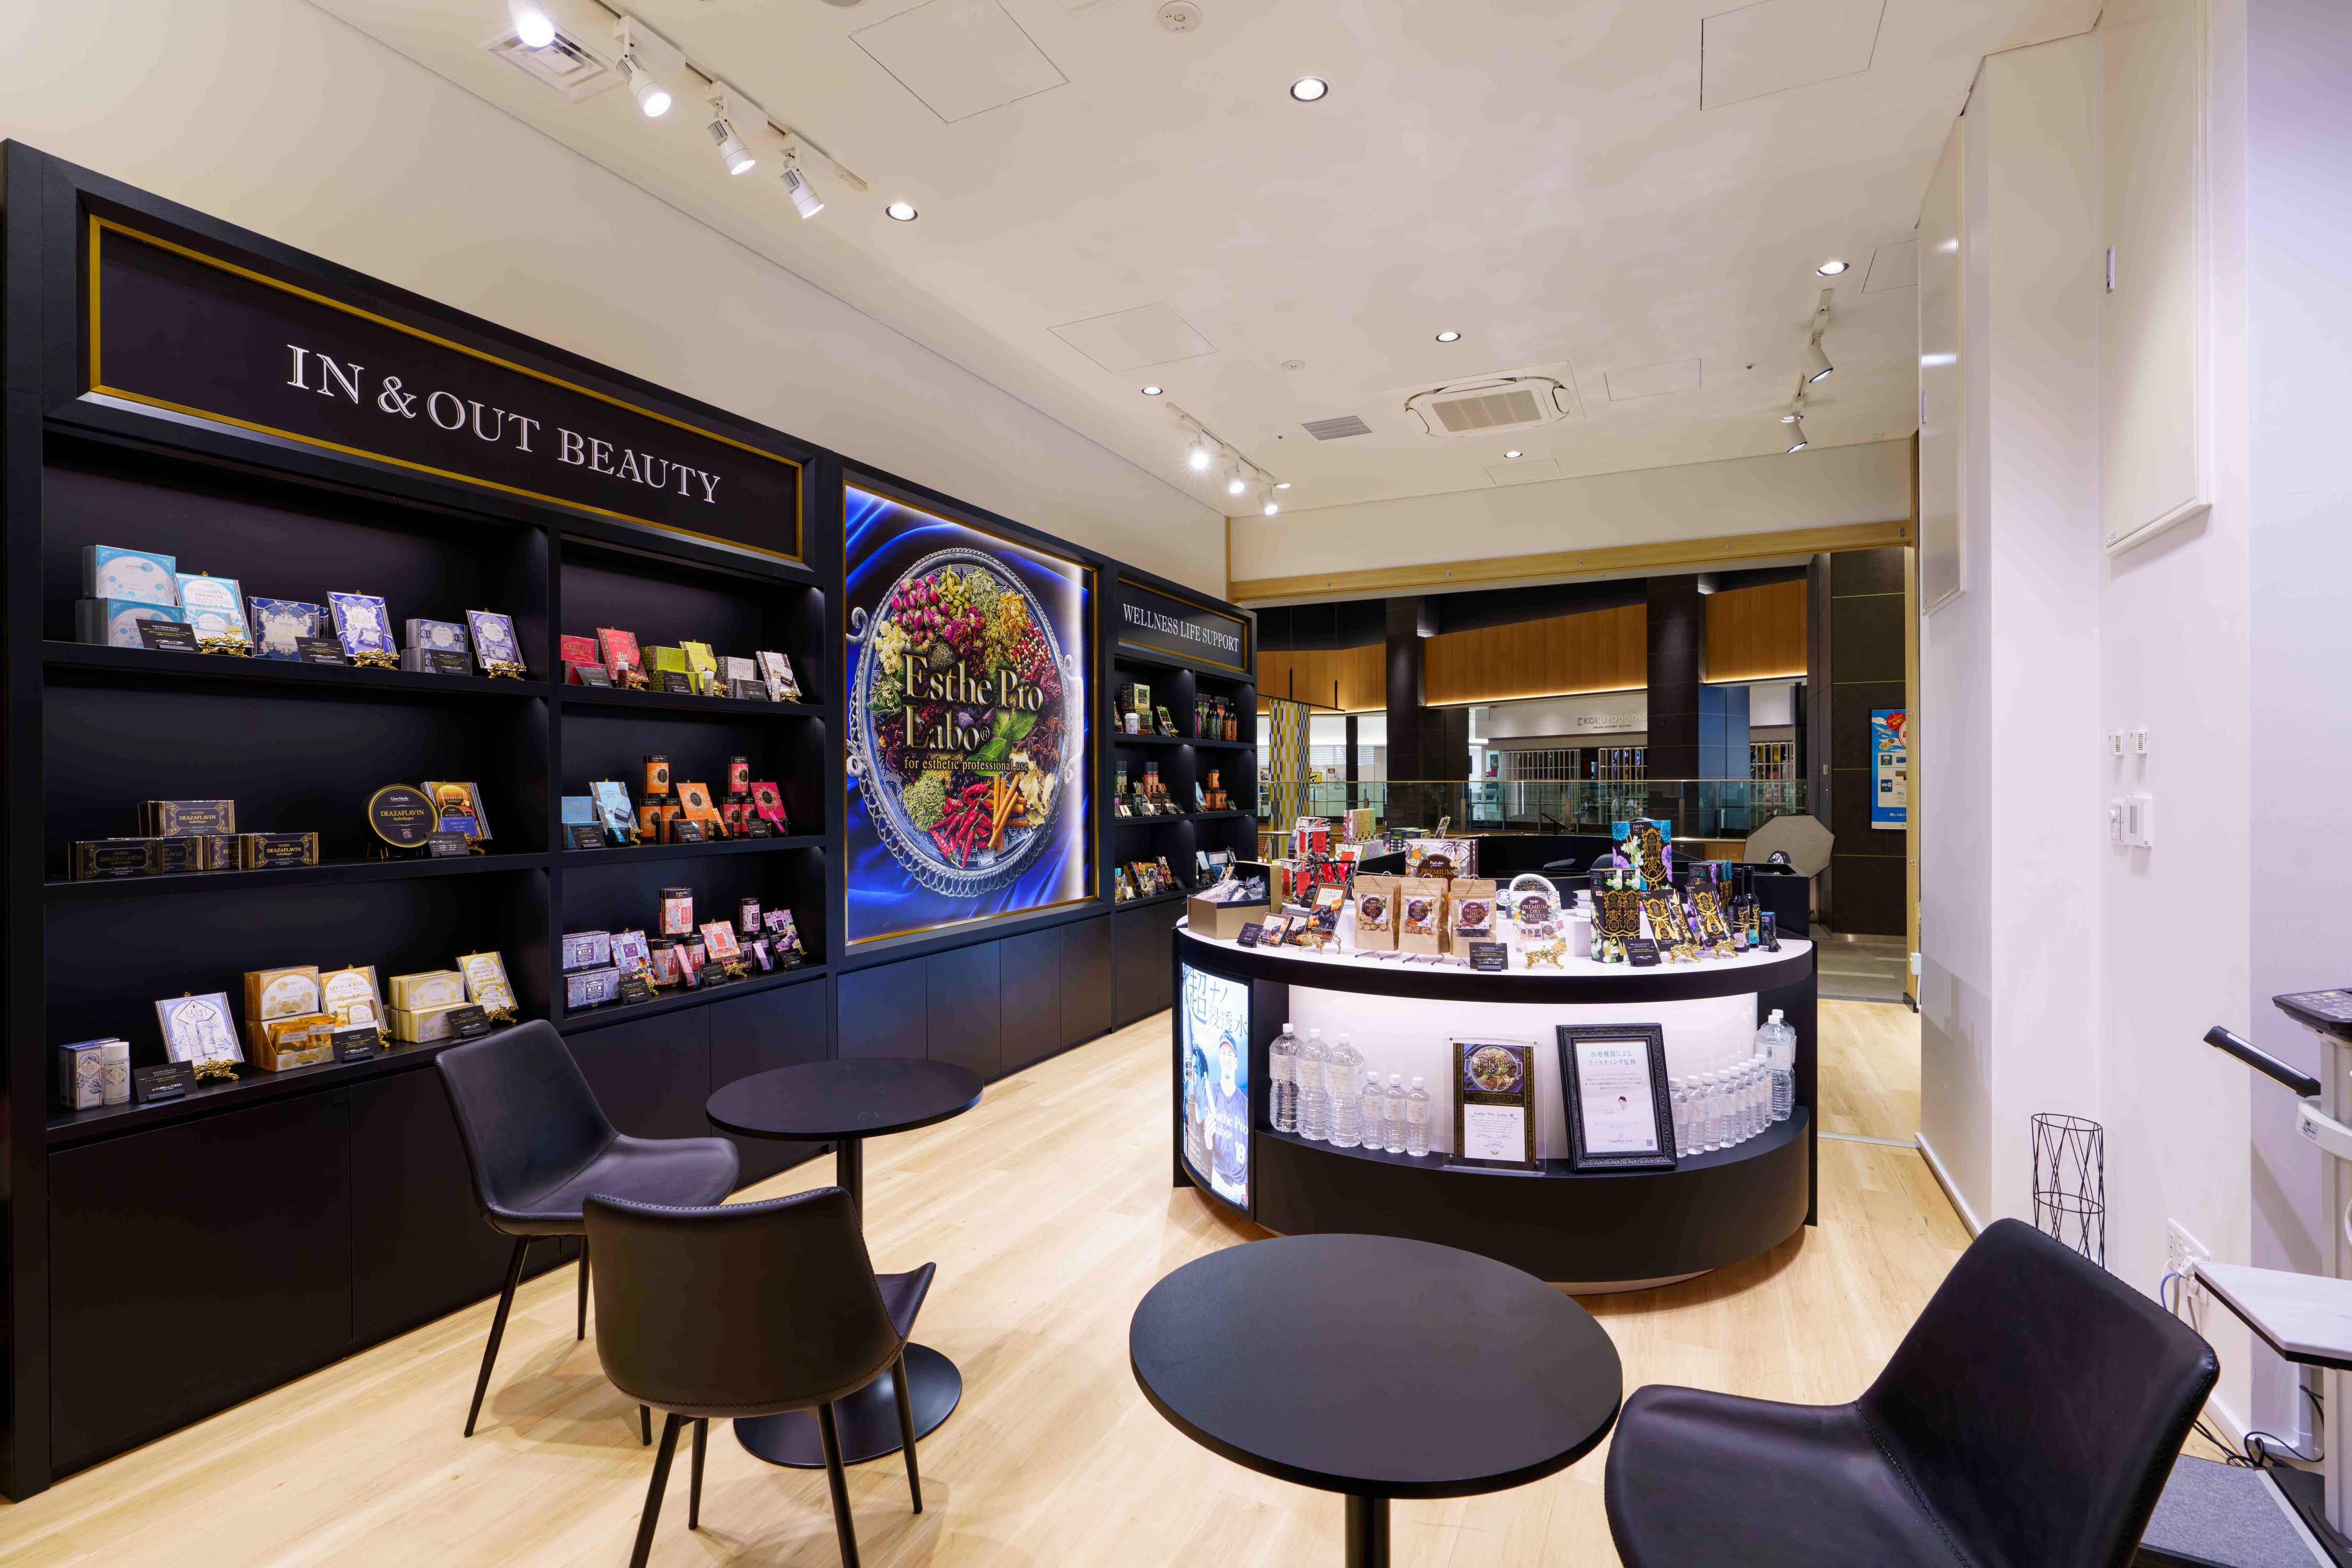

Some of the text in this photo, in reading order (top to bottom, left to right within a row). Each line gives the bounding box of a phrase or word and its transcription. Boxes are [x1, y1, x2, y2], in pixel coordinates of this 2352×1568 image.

[287, 344, 721, 504] IN & OUT BEAUTY
[1123, 604, 1239, 652] WELLNESS LIFE SUPPORT
[903, 654, 1043, 711] Esthe Pro
[905, 757, 919, 769] for
[923, 758, 959, 769] esthetic
[963, 758, 1013, 773] professional
[1209, 1005, 1248, 1037] 浸透水
[1216, 1110, 1248, 1135] sthe Pro
[1235, 1141, 1246, 1165] 18
